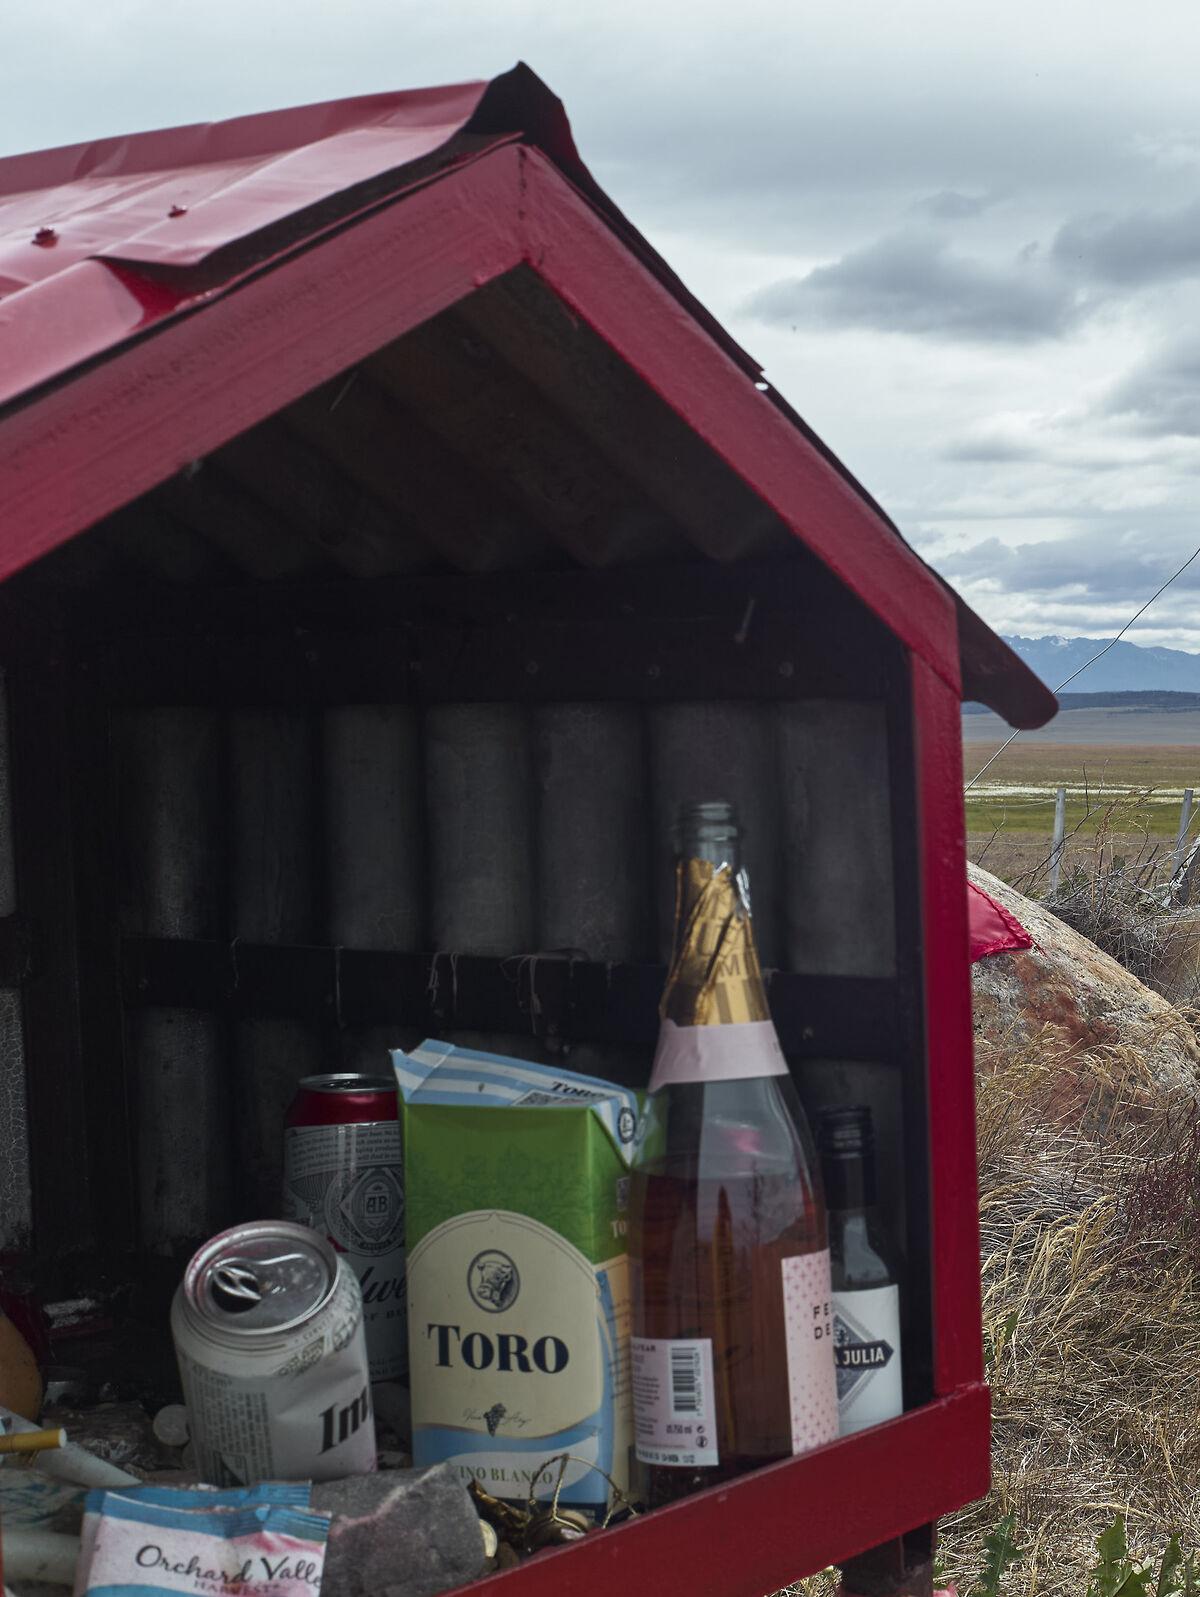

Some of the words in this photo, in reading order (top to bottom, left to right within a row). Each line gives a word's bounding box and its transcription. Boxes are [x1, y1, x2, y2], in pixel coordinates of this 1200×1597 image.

[426, 1322, 570, 1375] TORO
[842, 1346, 885, 1365] JULIA
[490, 1468, 554, 1485] BLANCO
[135, 1544, 253, 1584] Orchard
